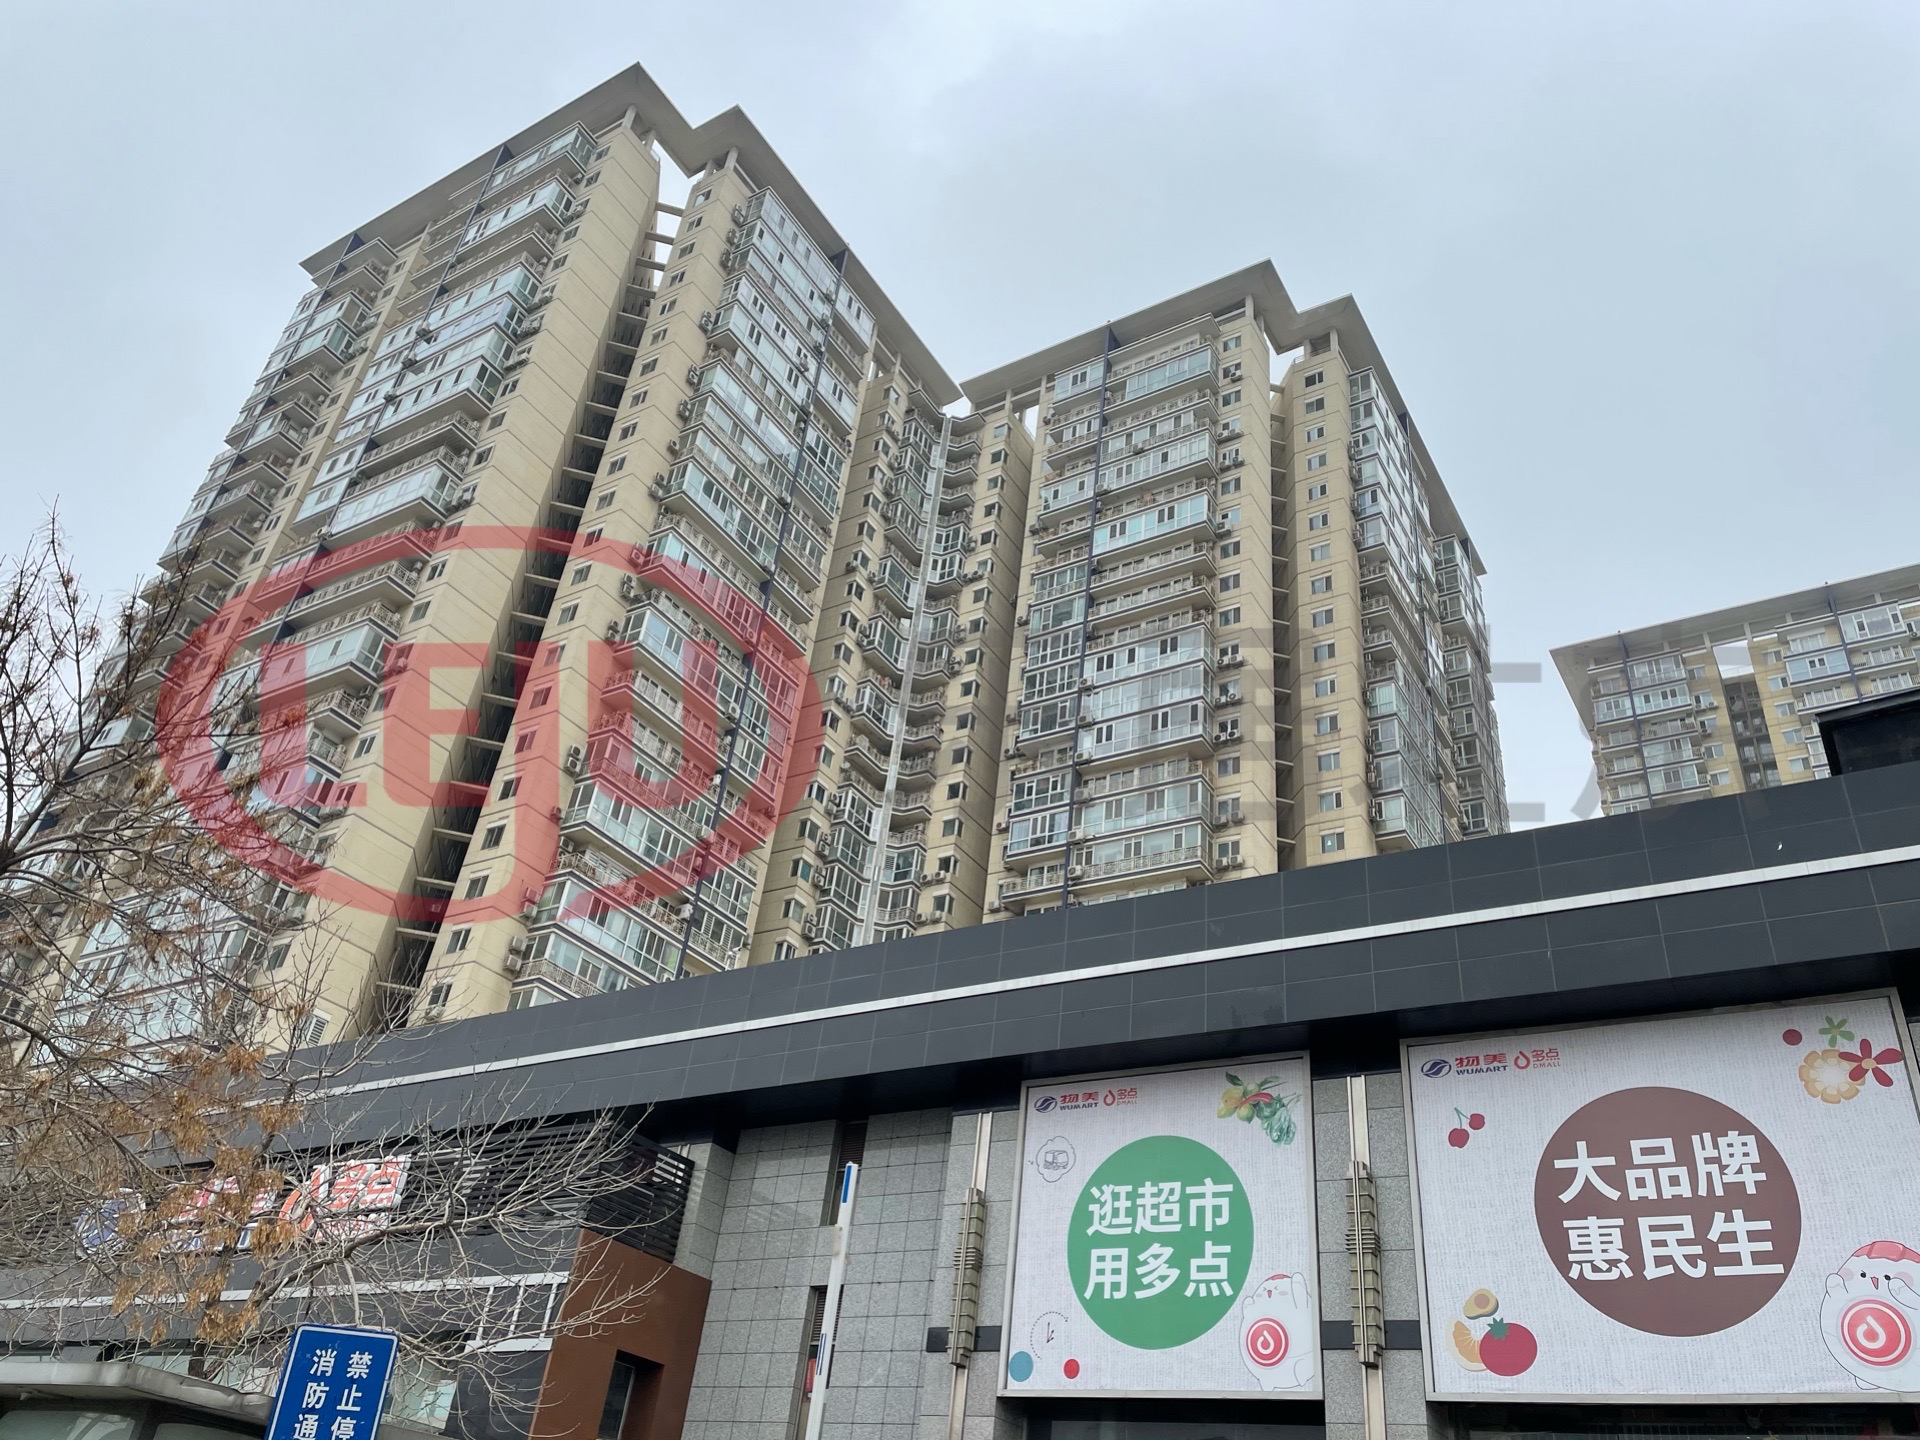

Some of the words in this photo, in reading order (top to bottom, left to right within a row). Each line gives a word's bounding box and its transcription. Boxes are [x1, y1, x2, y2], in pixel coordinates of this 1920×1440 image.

[1455, 1053, 1508, 1068] 物美
[1531, 1048, 1560, 1062] 多点
[1456, 1065, 1508, 1076] WUMART
[1533, 1061, 1561, 1069] DMALL
[1060, 1092, 1099, 1105] 物美
[1117, 1088, 1137, 1100] 多点
[1060, 1102, 1099, 1111] WUMART
[1553, 1130, 1767, 1204] 大品牌
[1086, 1178, 1233, 1236] 逛超市
[1562, 1209, 1784, 1281] 惠民生
[1084, 1241, 1234, 1300] 用多点
